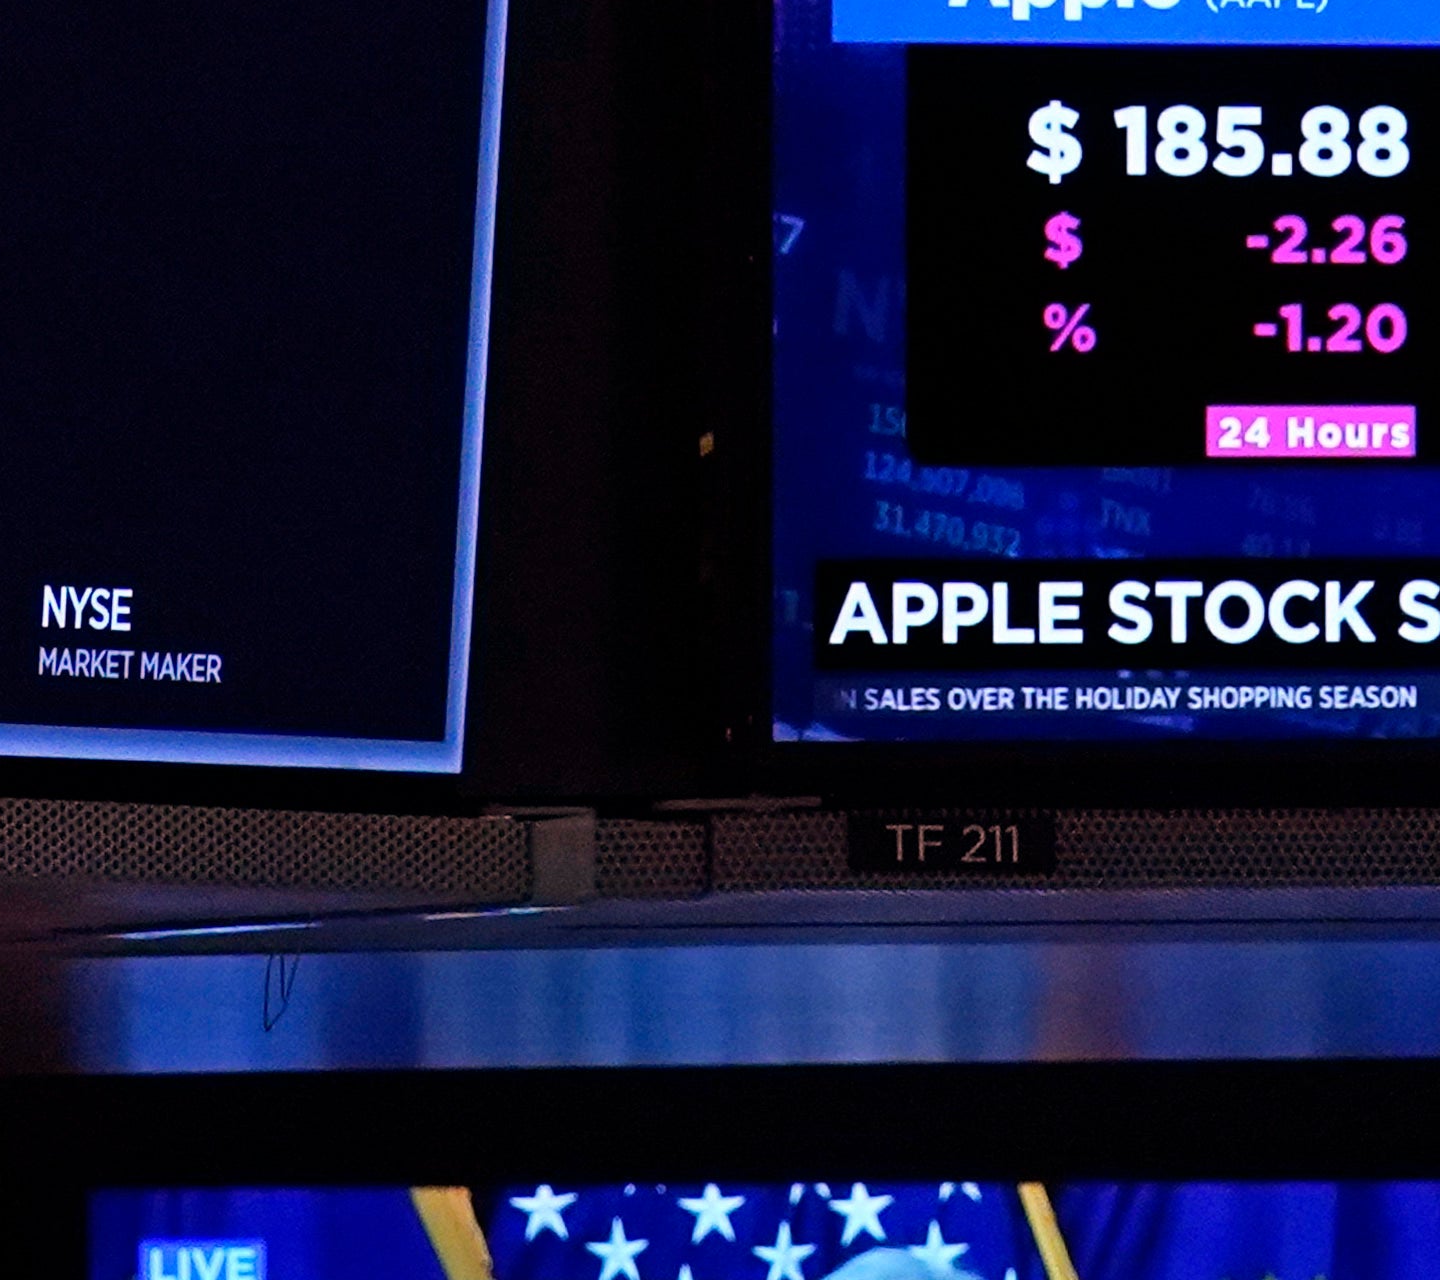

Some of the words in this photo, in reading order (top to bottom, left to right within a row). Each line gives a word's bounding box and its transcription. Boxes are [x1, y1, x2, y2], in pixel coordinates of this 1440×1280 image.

[1114, 105, 1410, 178] 185.88
[1246, 215, 1408, 265] -2.26
[1254, 303, 1408, 354] -1.20
[1218, 418, 1271, 450] 24
[1287, 416, 1411, 450] Hours
[42, 585, 133, 631] NYSE
[829, 581, 1082, 644] APPLE
[1108, 581, 1376, 643] STOCK
[38, 647, 134, 679] MARKET
[140, 652, 222, 683] MAKER
[865, 688, 940, 710] SALES
[948, 688, 1014, 710] OVER
[1022, 688, 1069, 709] THE
[1076, 687, 1179, 709] HOLIDAY
[1188, 686, 1311, 709] SHOPPING
[1319, 686, 1417, 708] SEASON
[887, 824, 944, 862] TF
[961, 824, 1019, 862] 211
